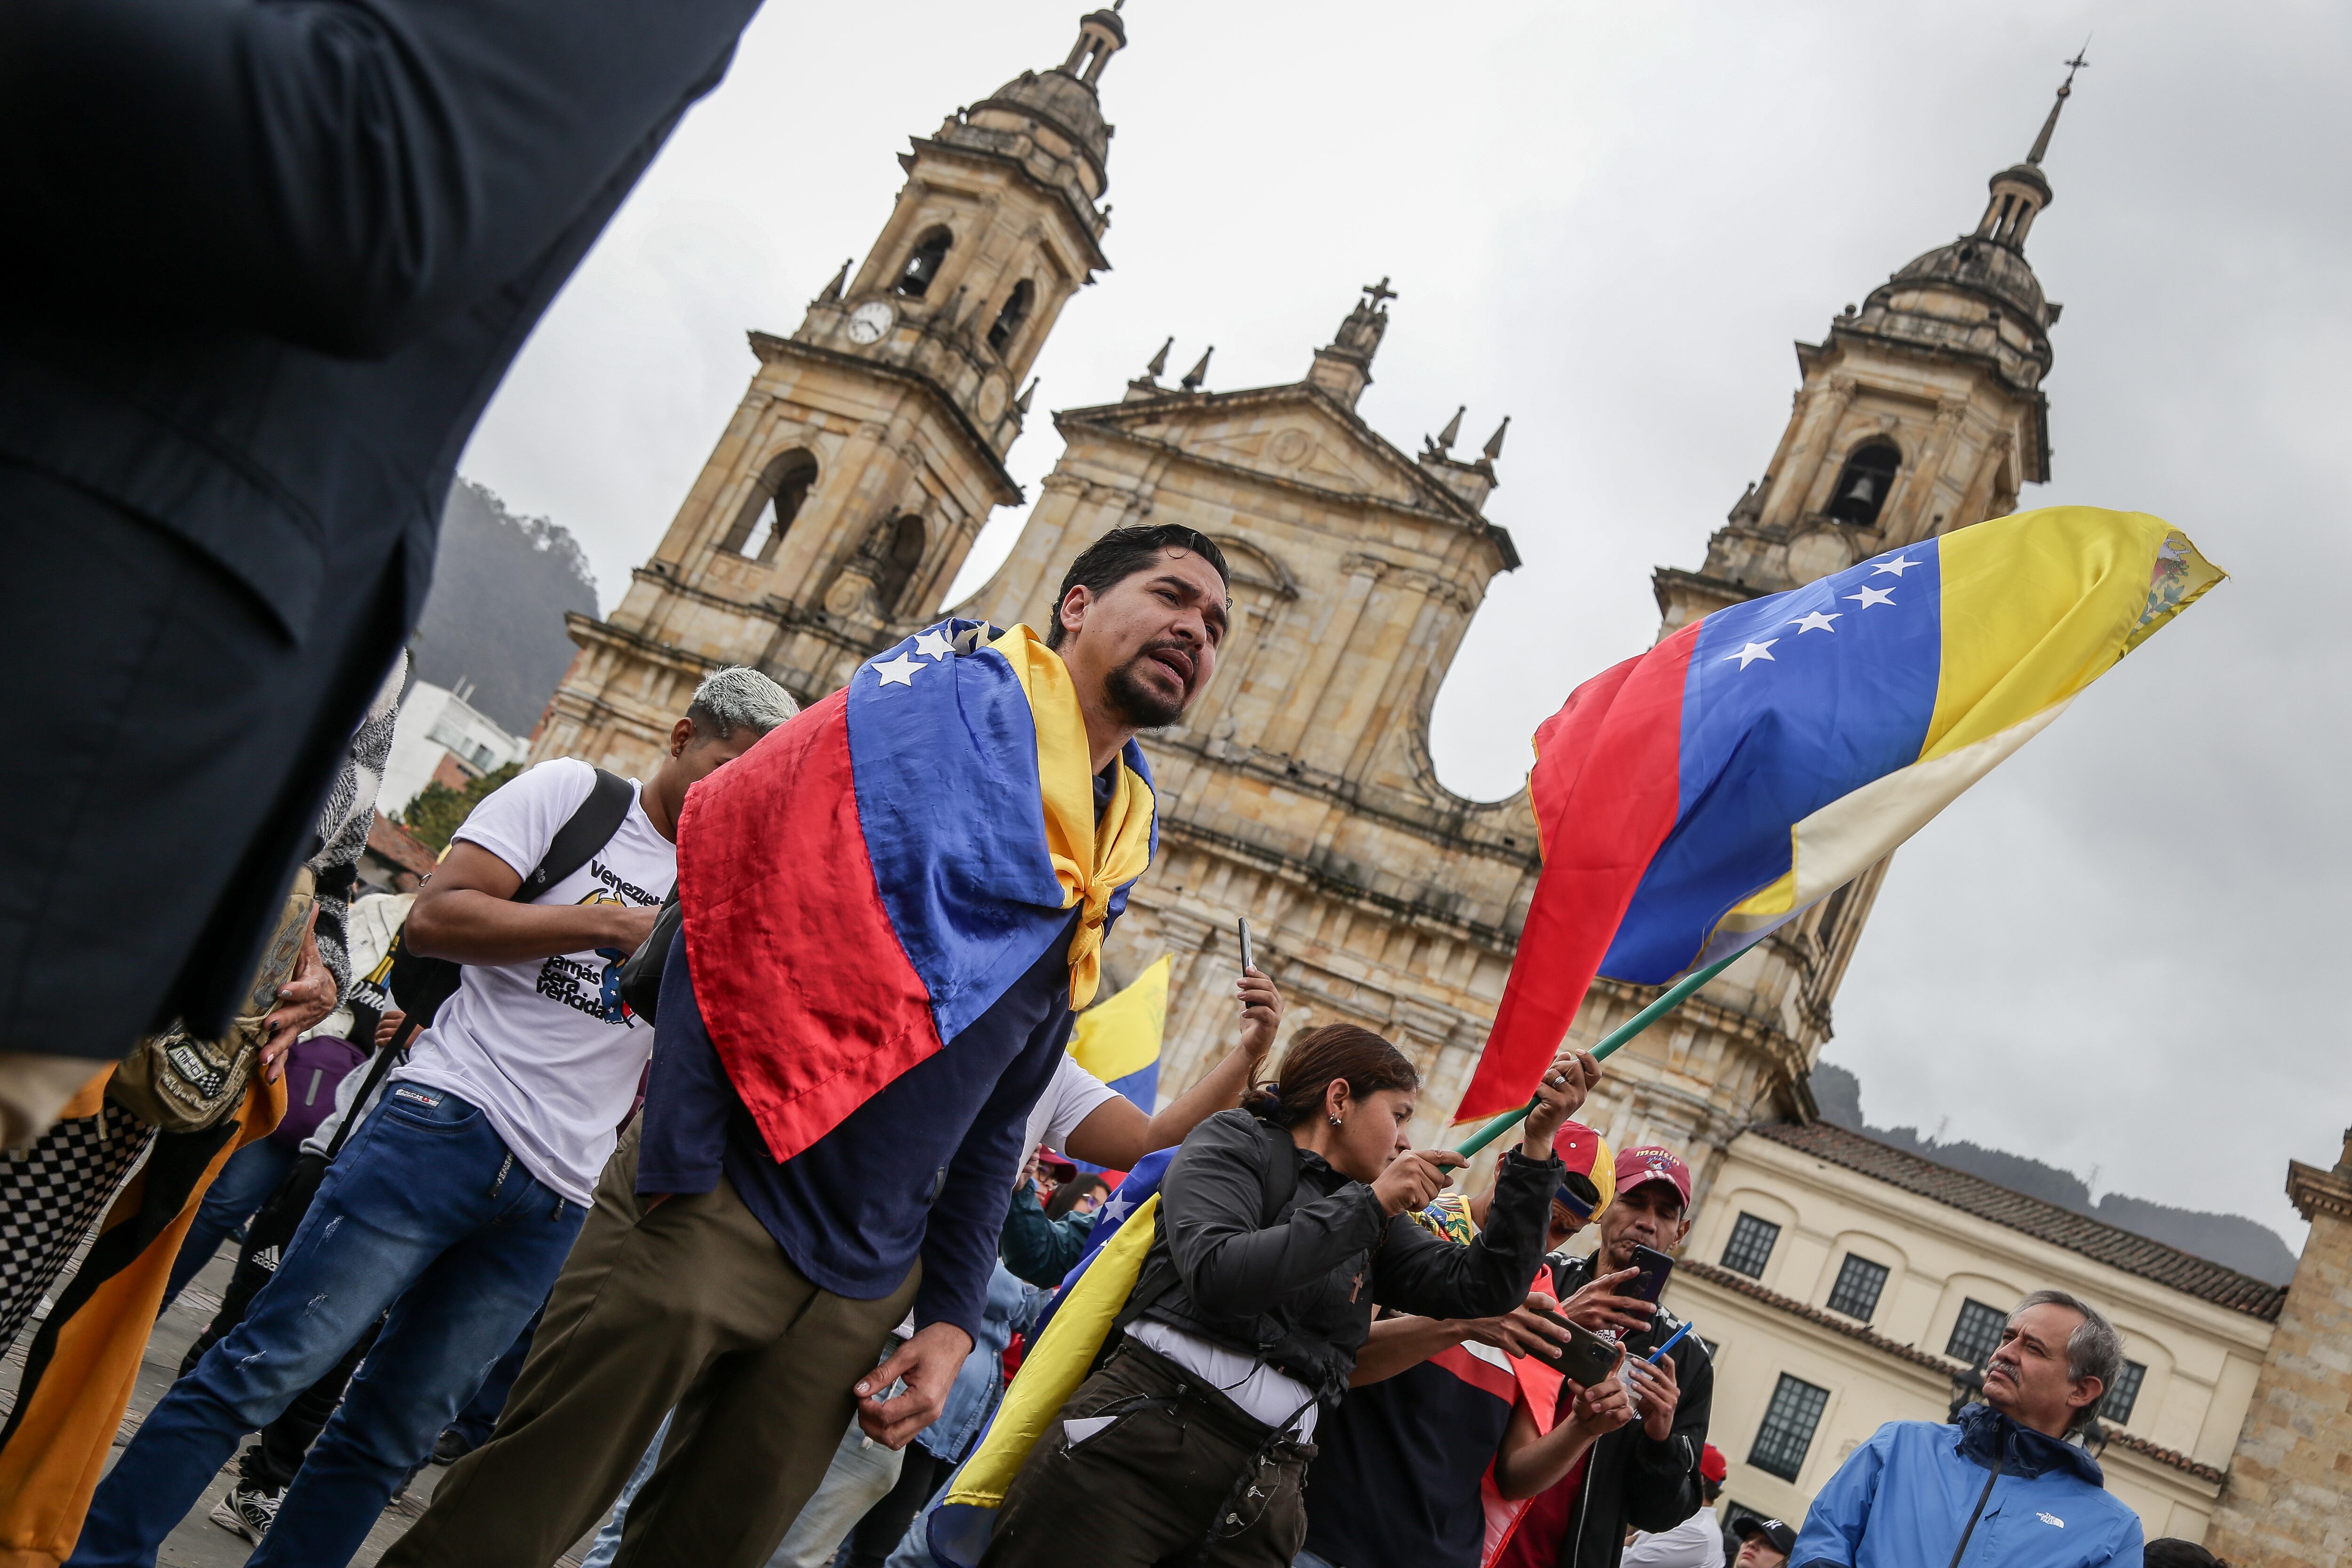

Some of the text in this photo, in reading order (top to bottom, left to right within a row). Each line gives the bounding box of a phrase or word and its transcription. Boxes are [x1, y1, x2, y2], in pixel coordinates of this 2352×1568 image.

[591, 859, 665, 907] Venezuel
[536, 979, 606, 1020] vencida
[252, 1255, 278, 1272] adida
[246, 1507, 265, 1524] N
